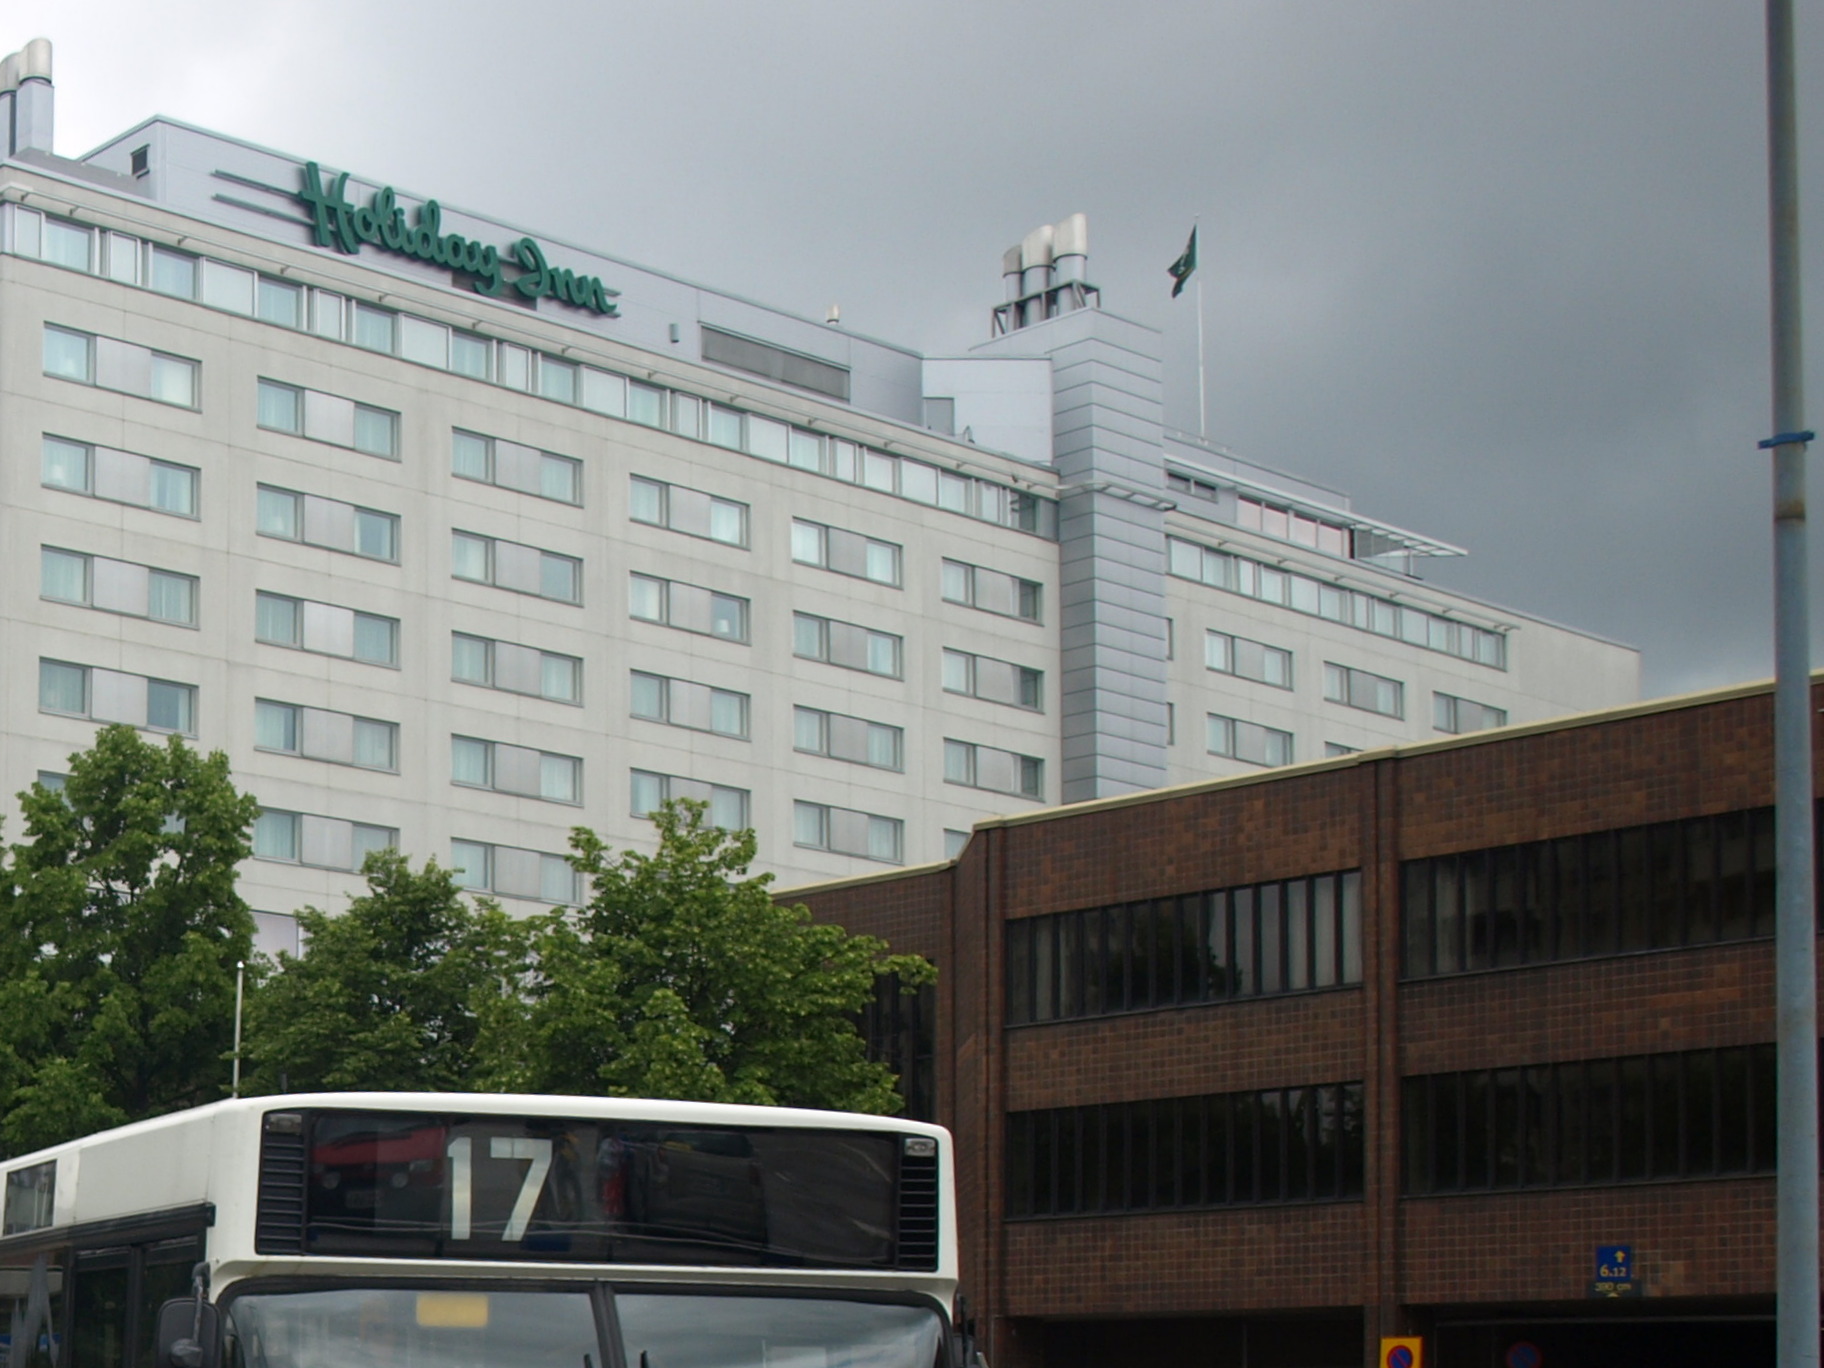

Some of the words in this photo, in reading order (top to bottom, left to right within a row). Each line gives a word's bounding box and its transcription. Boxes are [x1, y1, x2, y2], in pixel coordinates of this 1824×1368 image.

[298, 160, 503, 298] Holiday
[512, 237, 620, 315] Inn
[447, 1137, 553, 1242] 17
